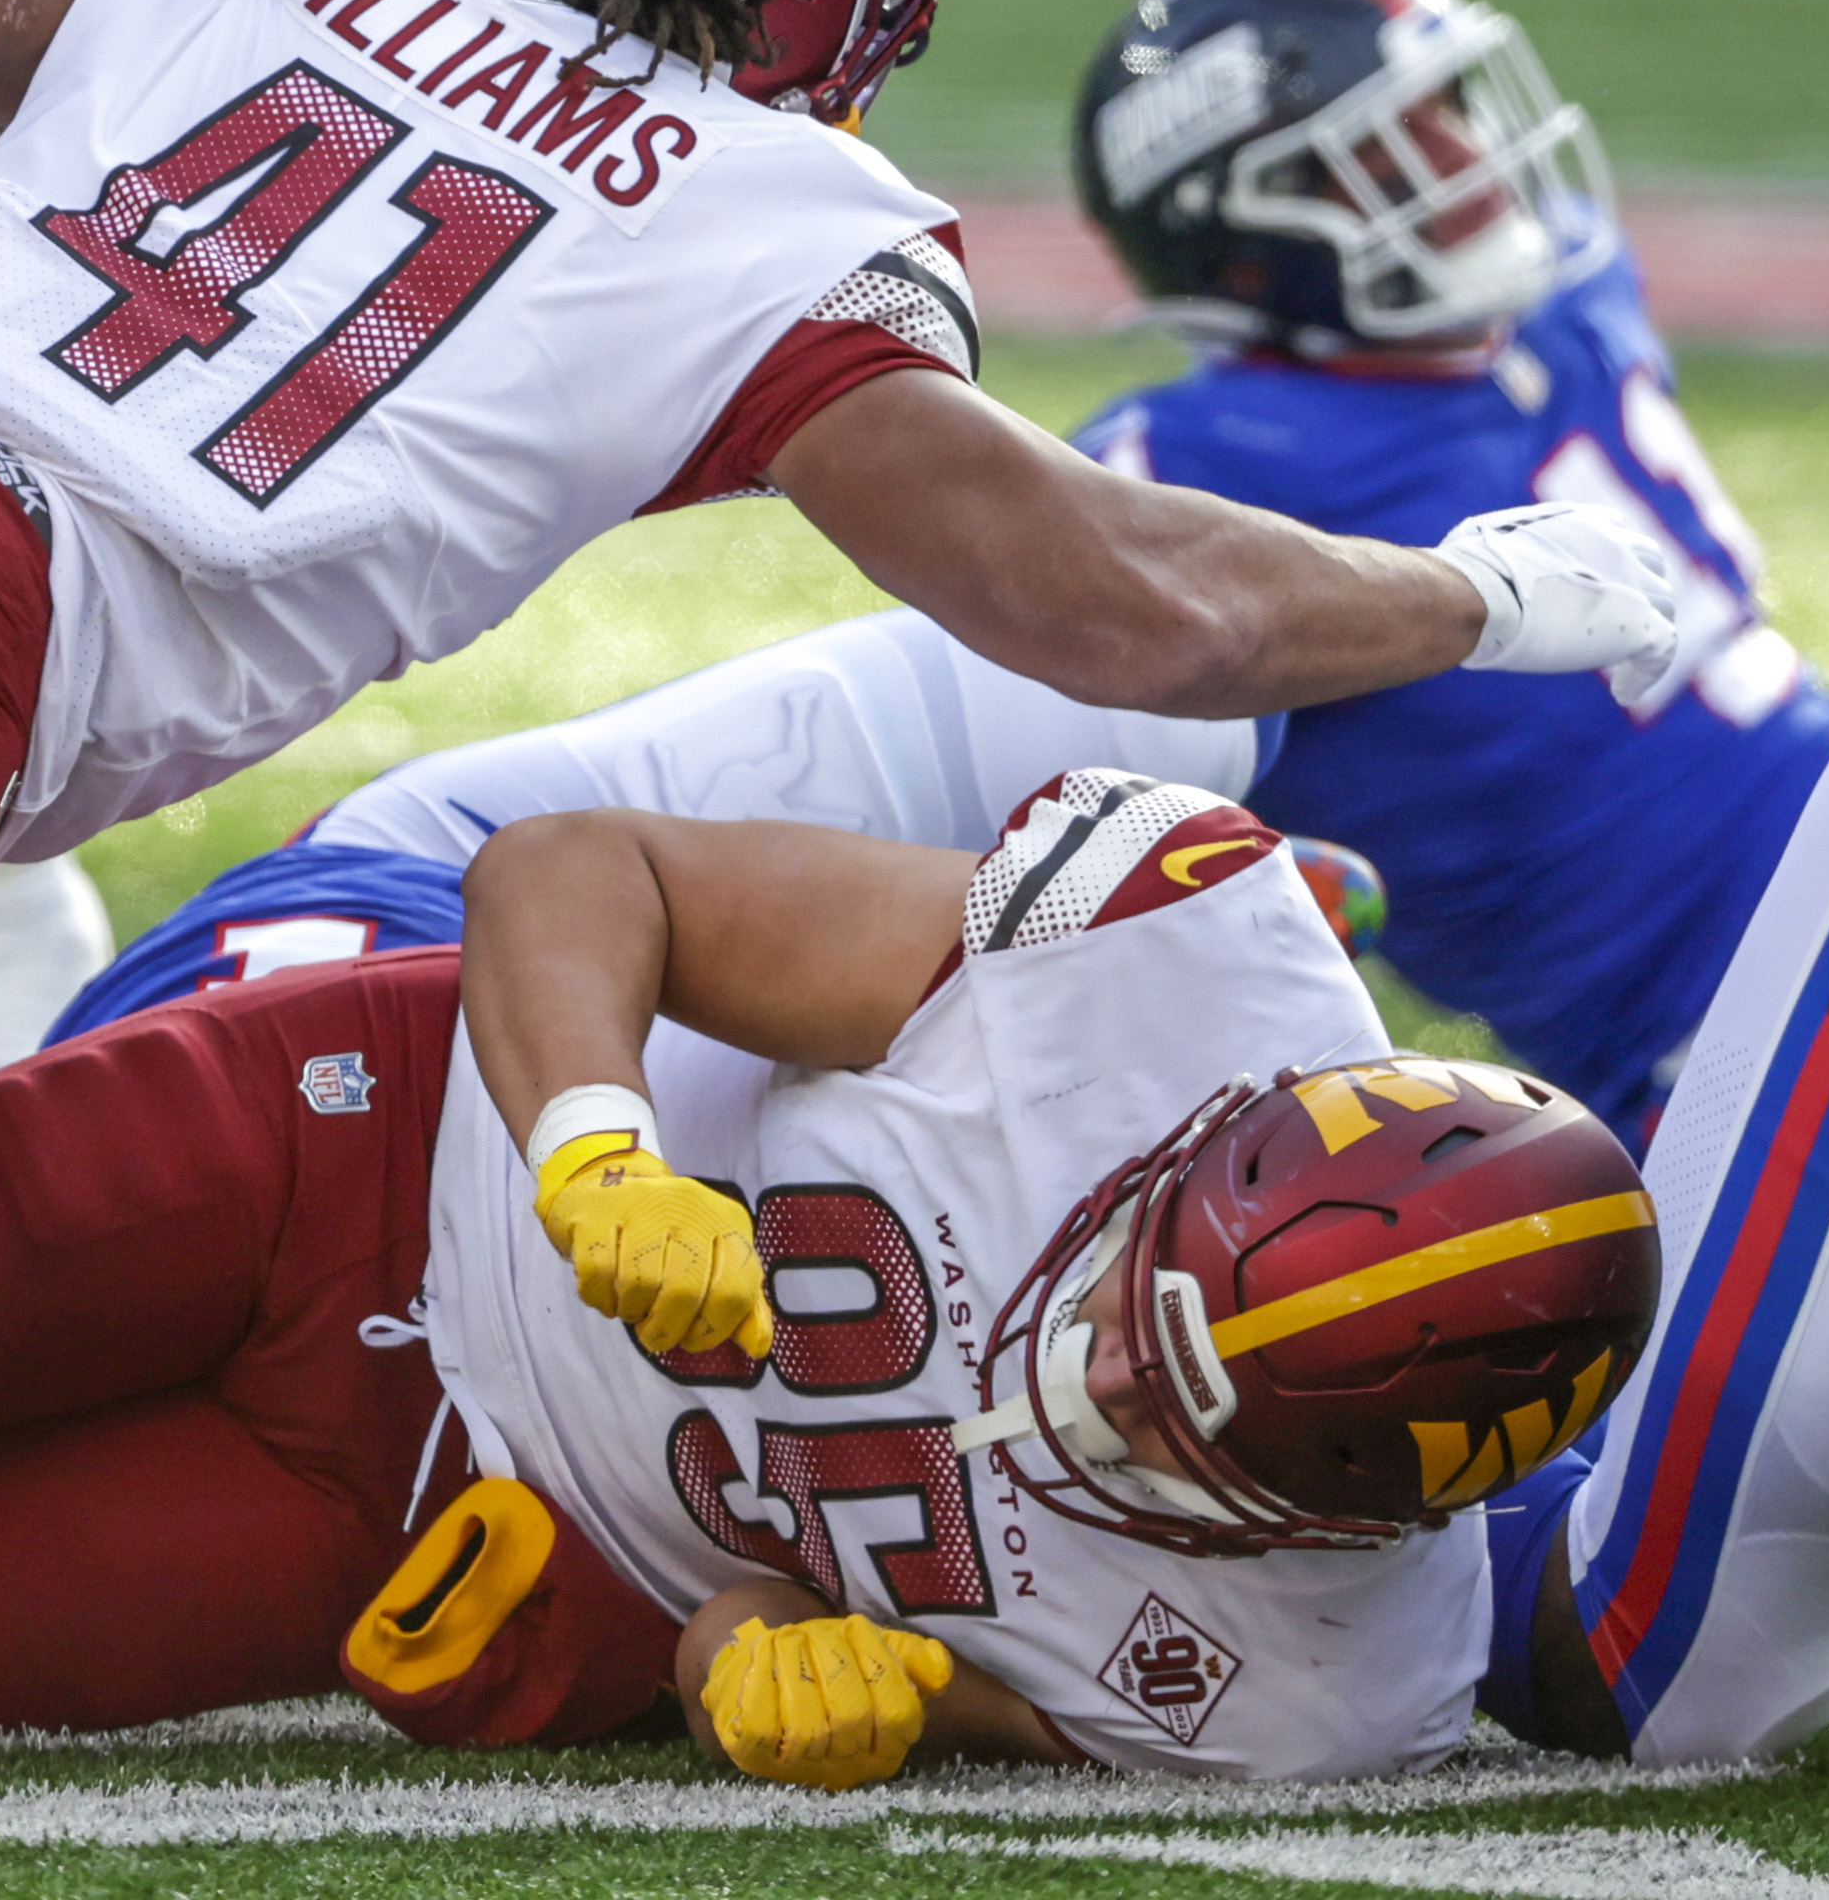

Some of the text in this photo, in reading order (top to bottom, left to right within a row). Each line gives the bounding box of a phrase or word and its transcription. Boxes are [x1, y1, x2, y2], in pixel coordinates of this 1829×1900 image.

[31, 56, 558, 510] 41
[312, 1064, 343, 1105] NFL
[1130, 1634, 1208, 1708] 90
